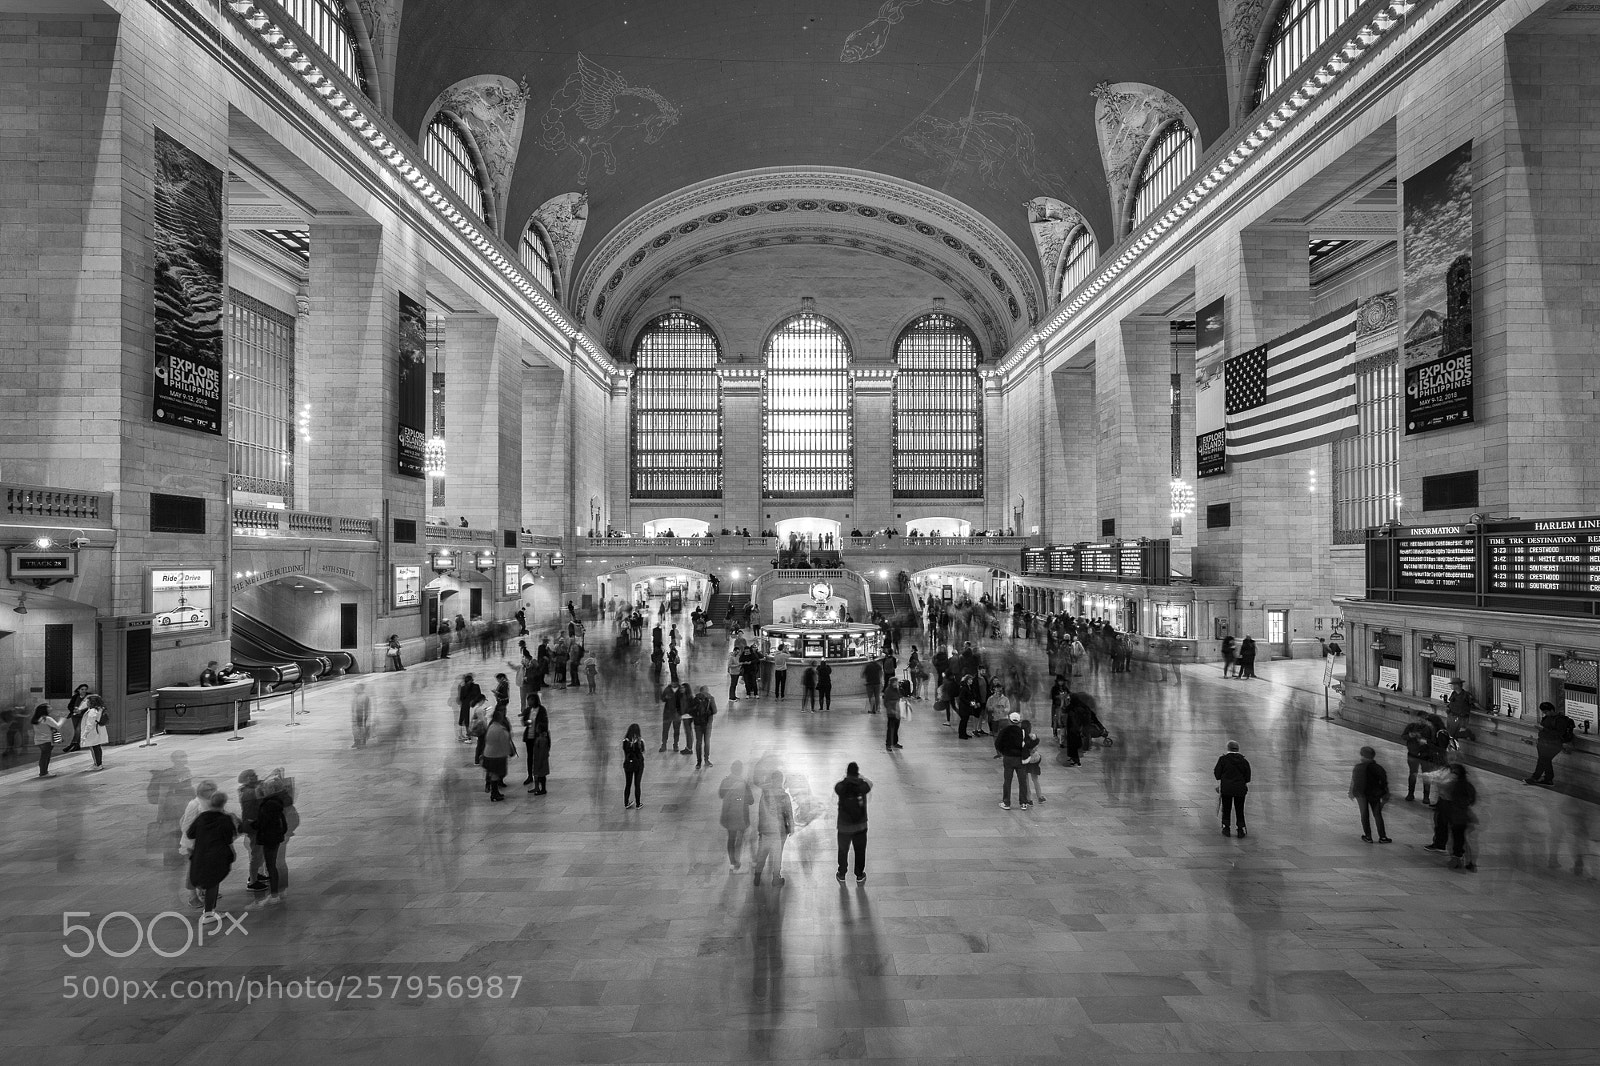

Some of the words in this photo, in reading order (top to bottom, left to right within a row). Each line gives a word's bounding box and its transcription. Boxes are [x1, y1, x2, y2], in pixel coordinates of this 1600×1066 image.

[170, 355, 219, 382] EXPLORE
[1419, 354, 1471, 380] EXPLORE
[170, 368, 219, 393] ISLANDS
[1419, 367, 1472, 391] ISLANDS
[170, 380, 219, 400] PHILIPPINES
[1419, 378, 1472, 398] PHILIPPINES
[170, 390, 182, 399] MAY
[1444, 392, 1458, 400] 2018
[1410, 526, 1460, 536] INFORMATION
[1535, 521, 1576, 531] HARLEM
[1578, 519, 1600, 528] LINE
[1527, 536, 1577, 544] DESTINATION
[1587, 535, 1600, 543] RE
[274, 564, 304, 577] BUILDING
[336, 565, 355, 578] STREET
[1529, 564, 1560, 572] SOUTHEAST
[1529, 573, 1560, 581] CRESTWOOD
[1529, 582, 1560, 590] SOUTHEAST
